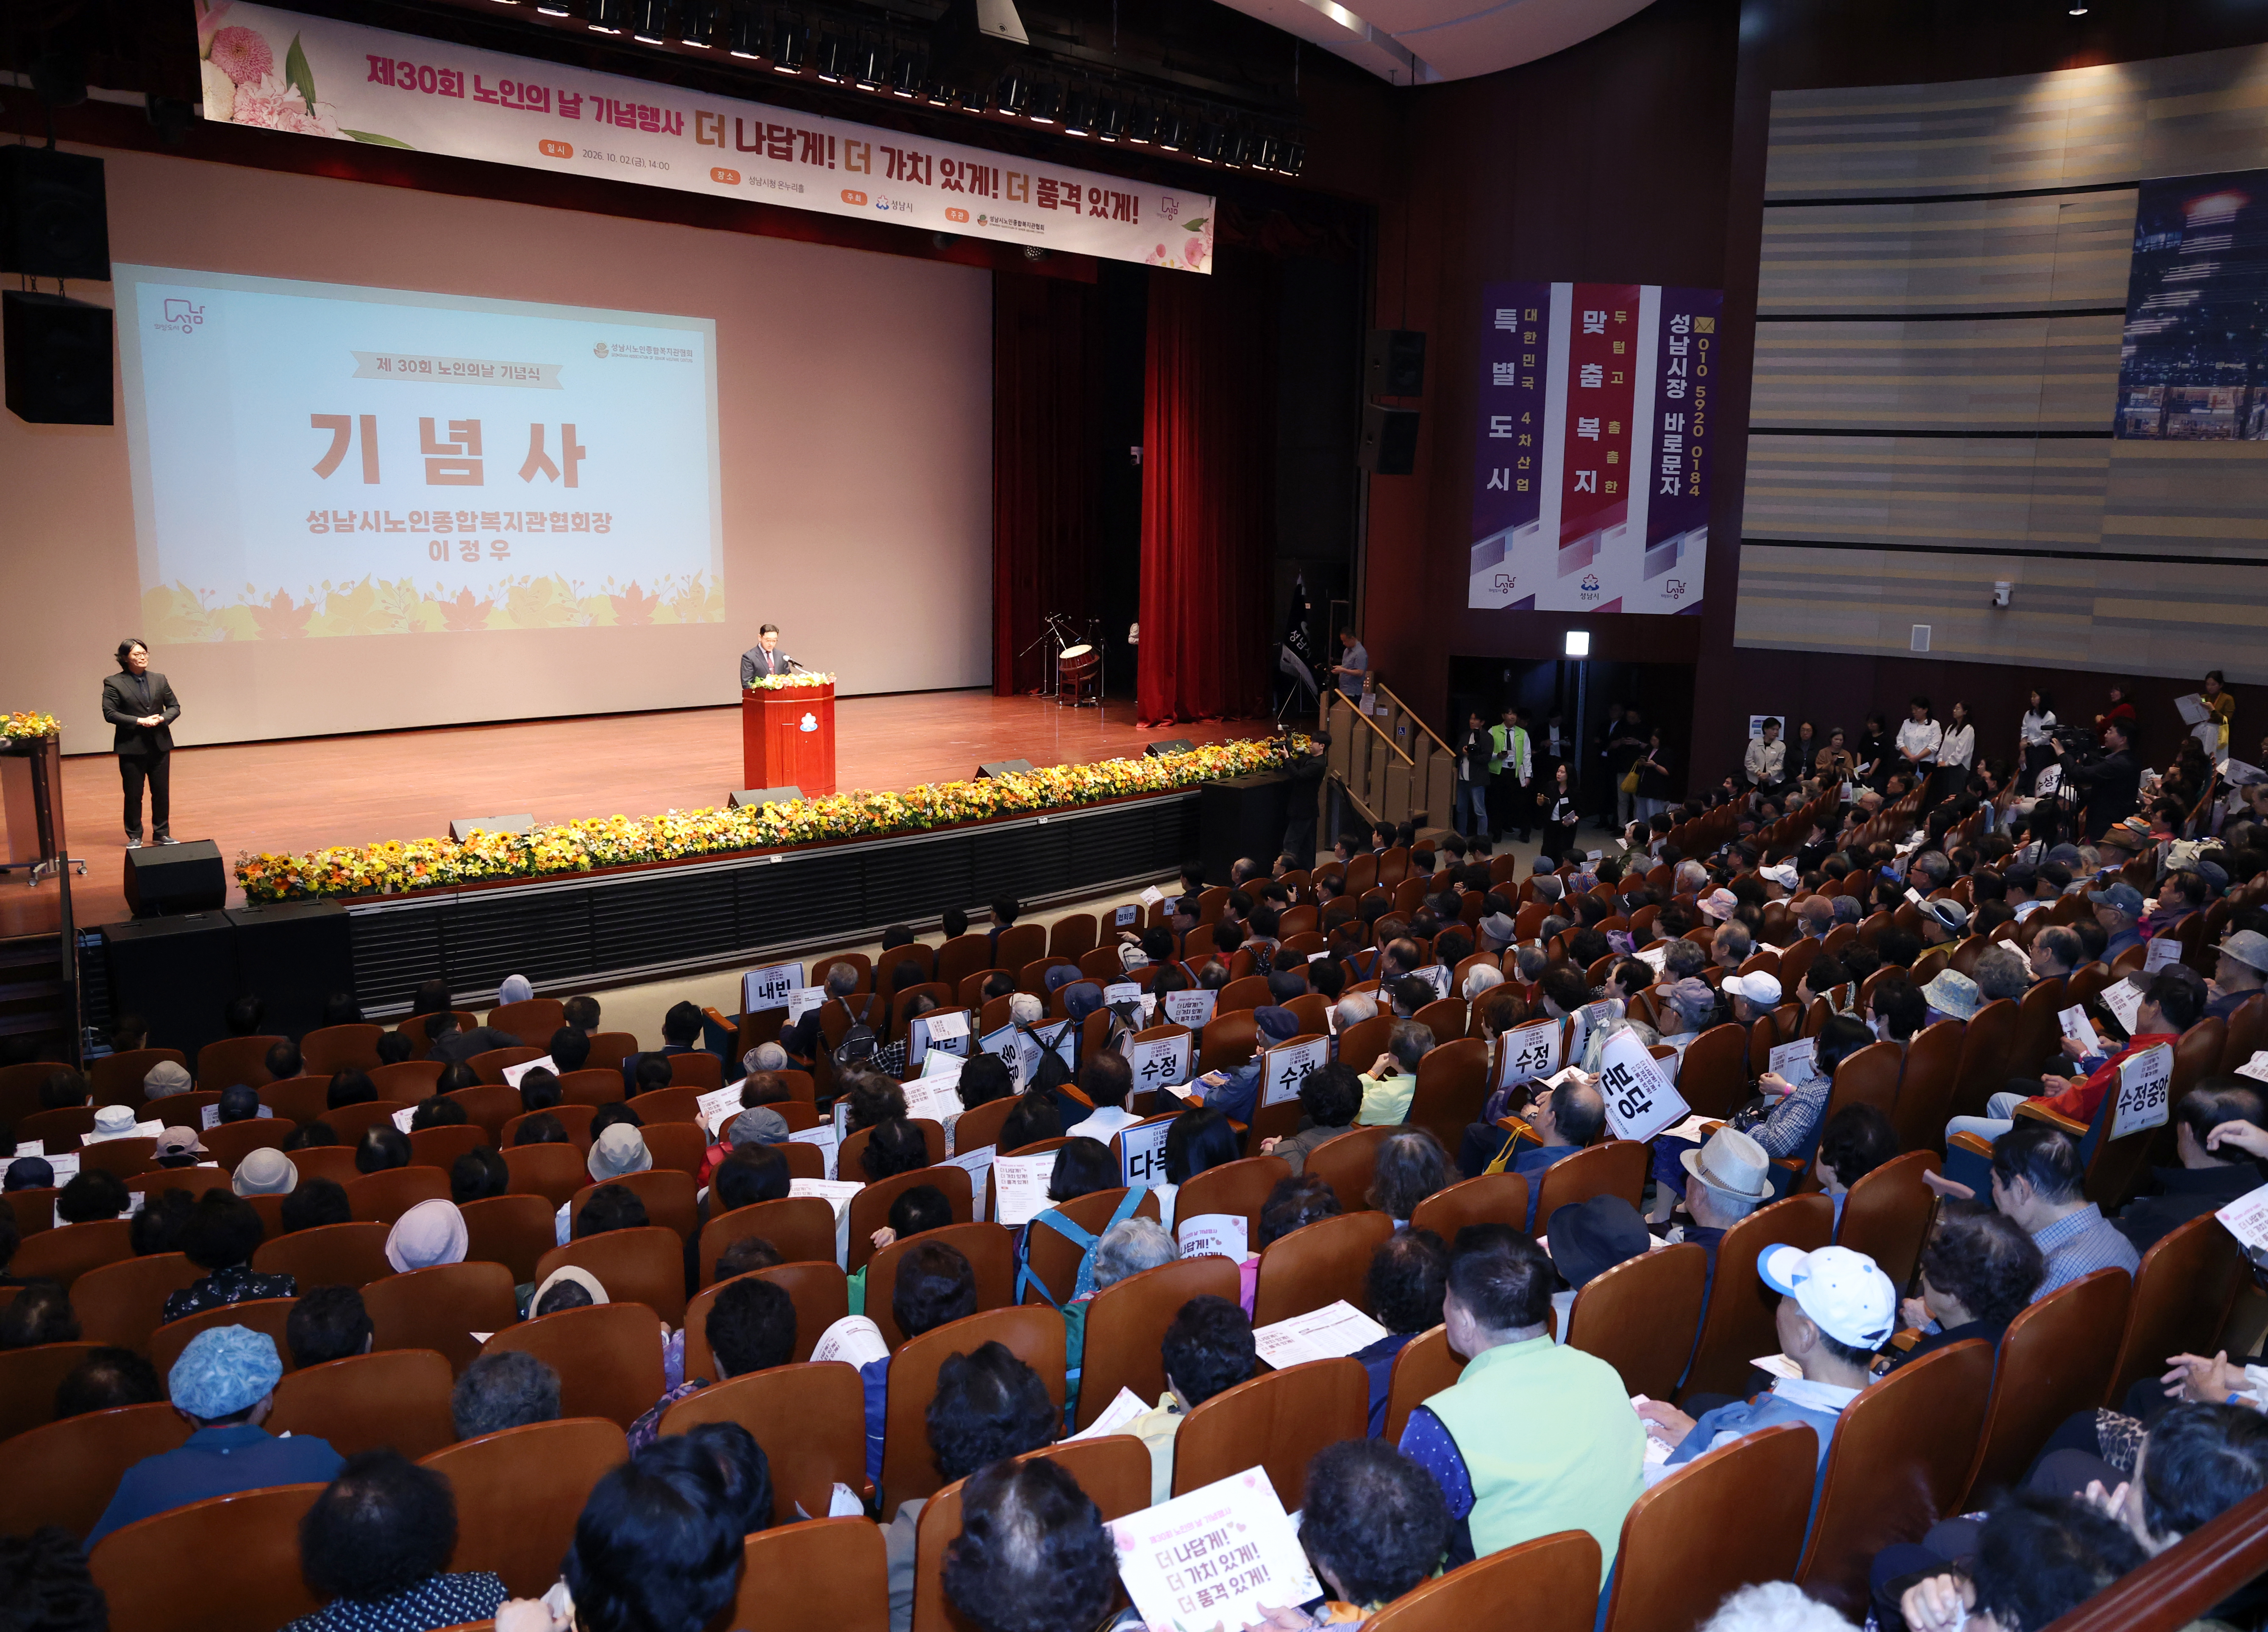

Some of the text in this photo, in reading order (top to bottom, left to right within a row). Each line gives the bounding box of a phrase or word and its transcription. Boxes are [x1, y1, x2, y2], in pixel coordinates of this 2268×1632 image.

[366, 55, 1139, 225] 제30회 노인의 날 기념행사 더 나답게! 더 가치 있게! 더 품격 있게!
[583, 149, 604, 161] 2026.
[607, 153, 617, 163] 10.
[649, 160, 670, 171] 14:00
[749, 175, 776, 189] 성남시청
[778, 181, 804, 193] 온누리홀
[891, 200, 913, 213] 성남시
[611, 344, 693, 357] 성남시노인종합복지관협회
[376, 357, 541, 381] 제 30회 노인의날 기념식
[1516, 309, 1538, 492] 대한민국 4차산업
[1660, 314, 1690, 496] 성남시장 바로문자
[1689, 338, 1709, 497] 010 5920 0184
[306, 509, 612, 534] 성남시노인종합복지관협회장
[1118, 912, 1134, 922] 협회장
[759, 979, 790, 999] 내빈
[1141, 1054, 1176, 1081] 수정
[1515, 1043, 1549, 1074] 수정
[1601, 1062, 1653, 1119] 분당
[2119, 1074, 2168, 1116] 수정중앙
[1181, 1238, 1209, 1254] 나답게!
[1155, 1528, 1231, 1569] 더 나답게!
[1166, 1542, 1261, 1592] 더 가치 있게!
[1177, 1564, 1271, 1614] 더 품격 있게!
